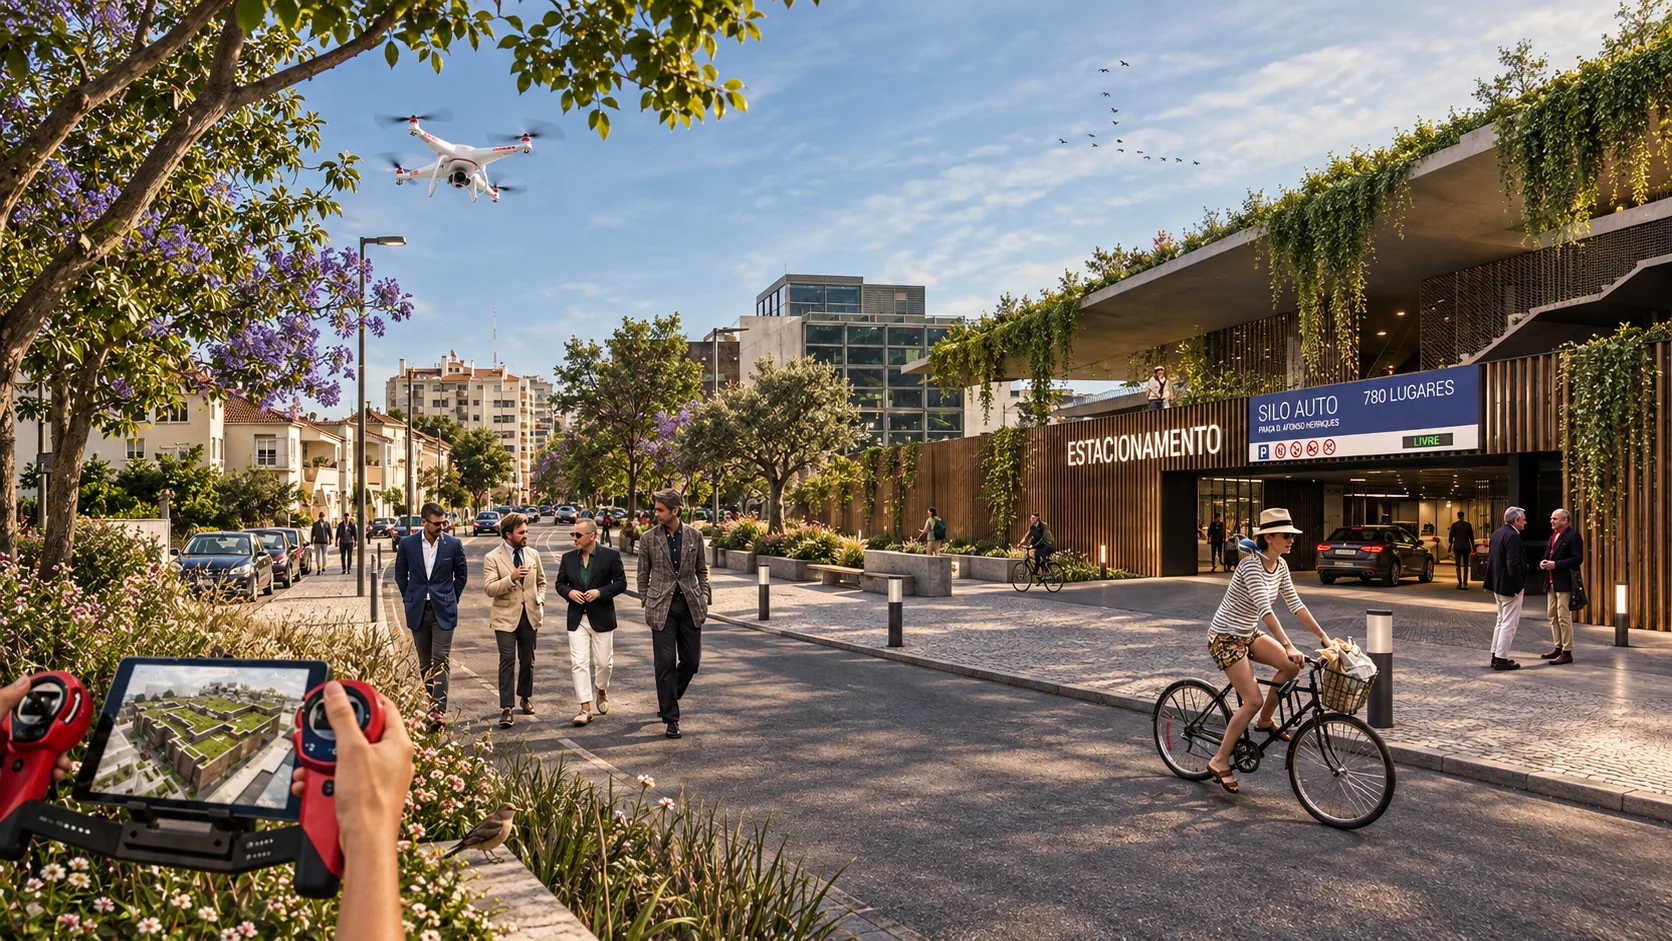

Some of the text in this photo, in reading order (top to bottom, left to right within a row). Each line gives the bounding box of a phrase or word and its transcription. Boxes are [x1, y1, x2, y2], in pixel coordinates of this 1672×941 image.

[1363, 379, 1455, 406] 780 LUGARES
[1258, 395, 1338, 422] SILO AUTO
[1067, 424, 1221, 467] ESTACIONAMENTO
[1260, 446, 1267, 458] P
[1413, 435, 1440, 447] LIVRE
